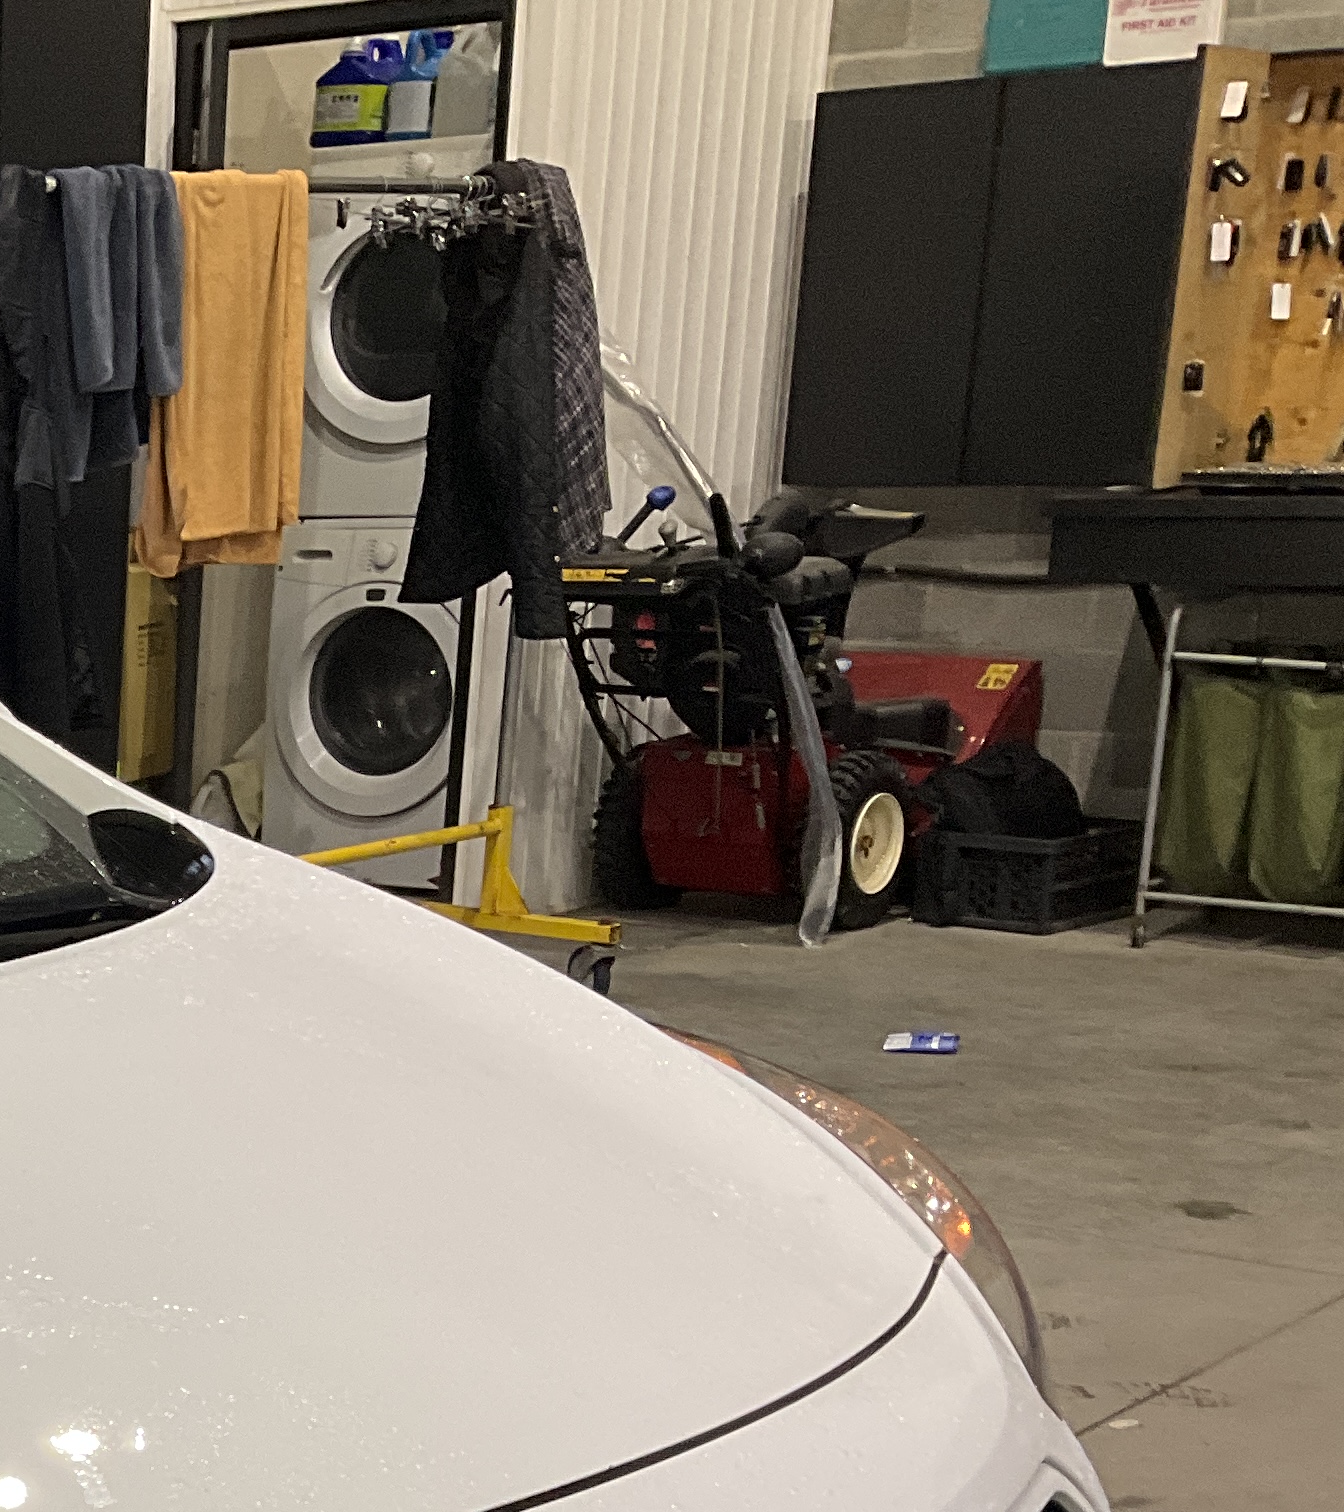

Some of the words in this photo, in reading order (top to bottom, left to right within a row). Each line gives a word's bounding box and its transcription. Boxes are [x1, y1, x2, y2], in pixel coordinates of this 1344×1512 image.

[1121, 20, 1154, 31] FIRST
[1157, 18, 1177, 28] AID
[1179, 15, 1197, 27] KIT
